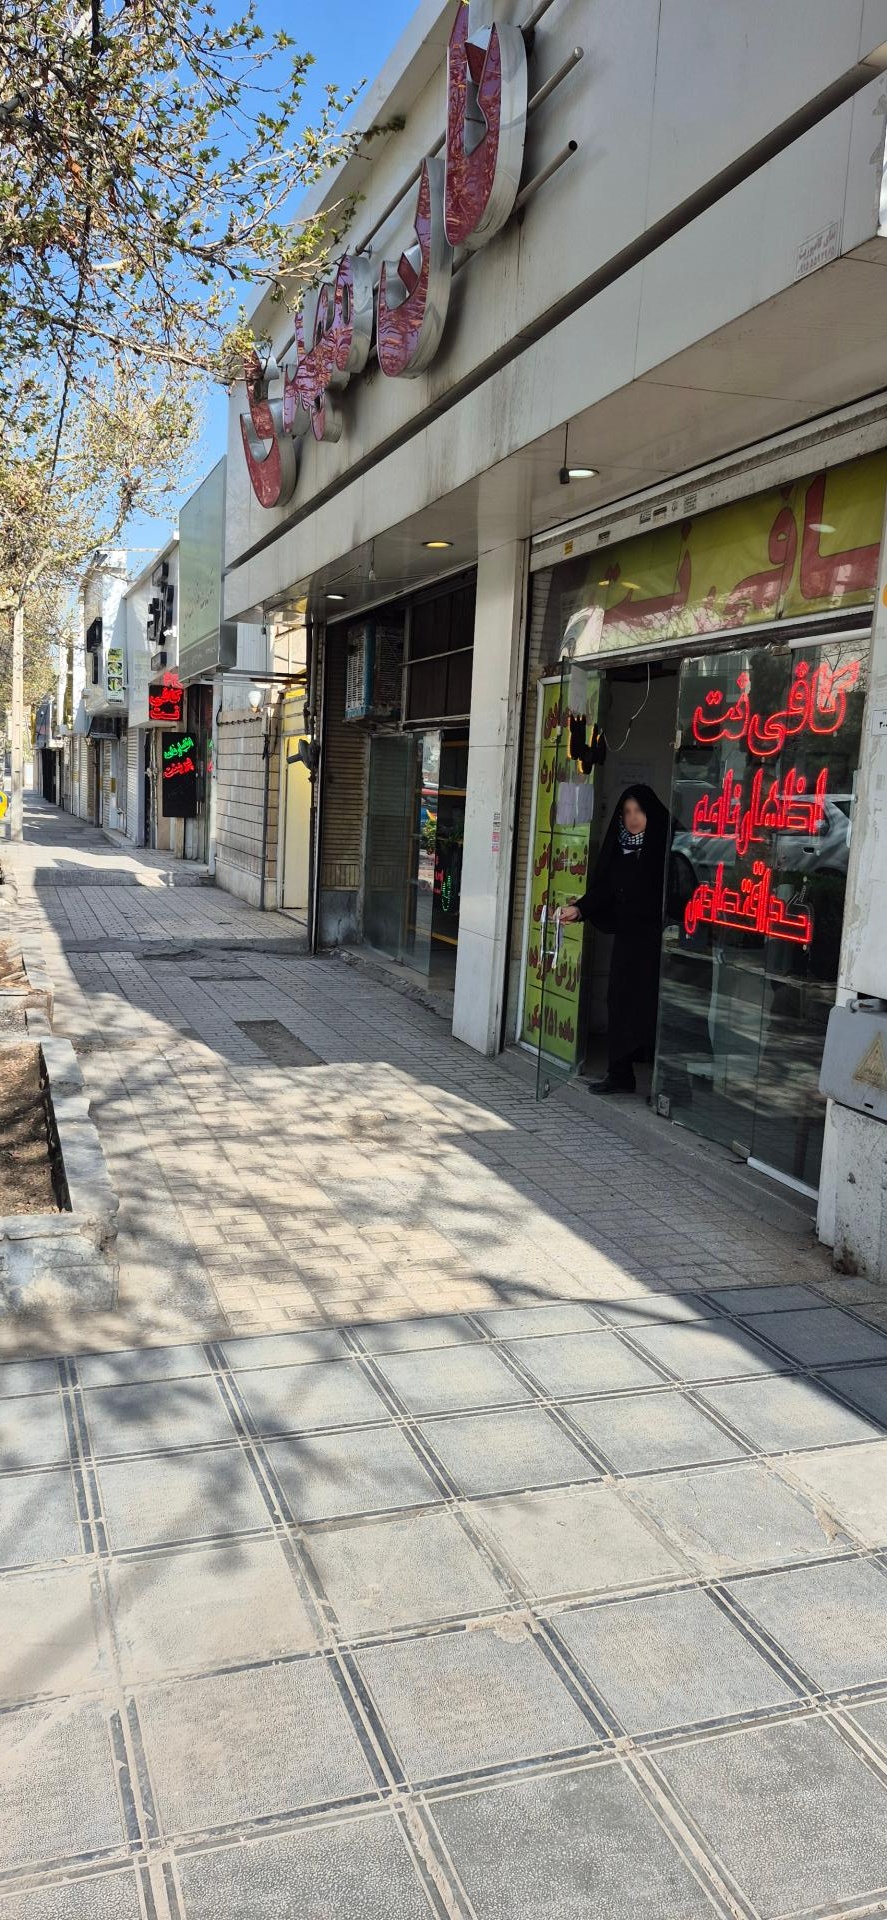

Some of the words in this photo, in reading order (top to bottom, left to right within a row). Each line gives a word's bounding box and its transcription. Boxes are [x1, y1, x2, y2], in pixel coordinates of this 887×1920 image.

[149, 687, 184, 706] کافی
[150, 705, 180, 720] نت
[692, 671, 752, 743] نت
[747, 661, 861, 756] کافی
